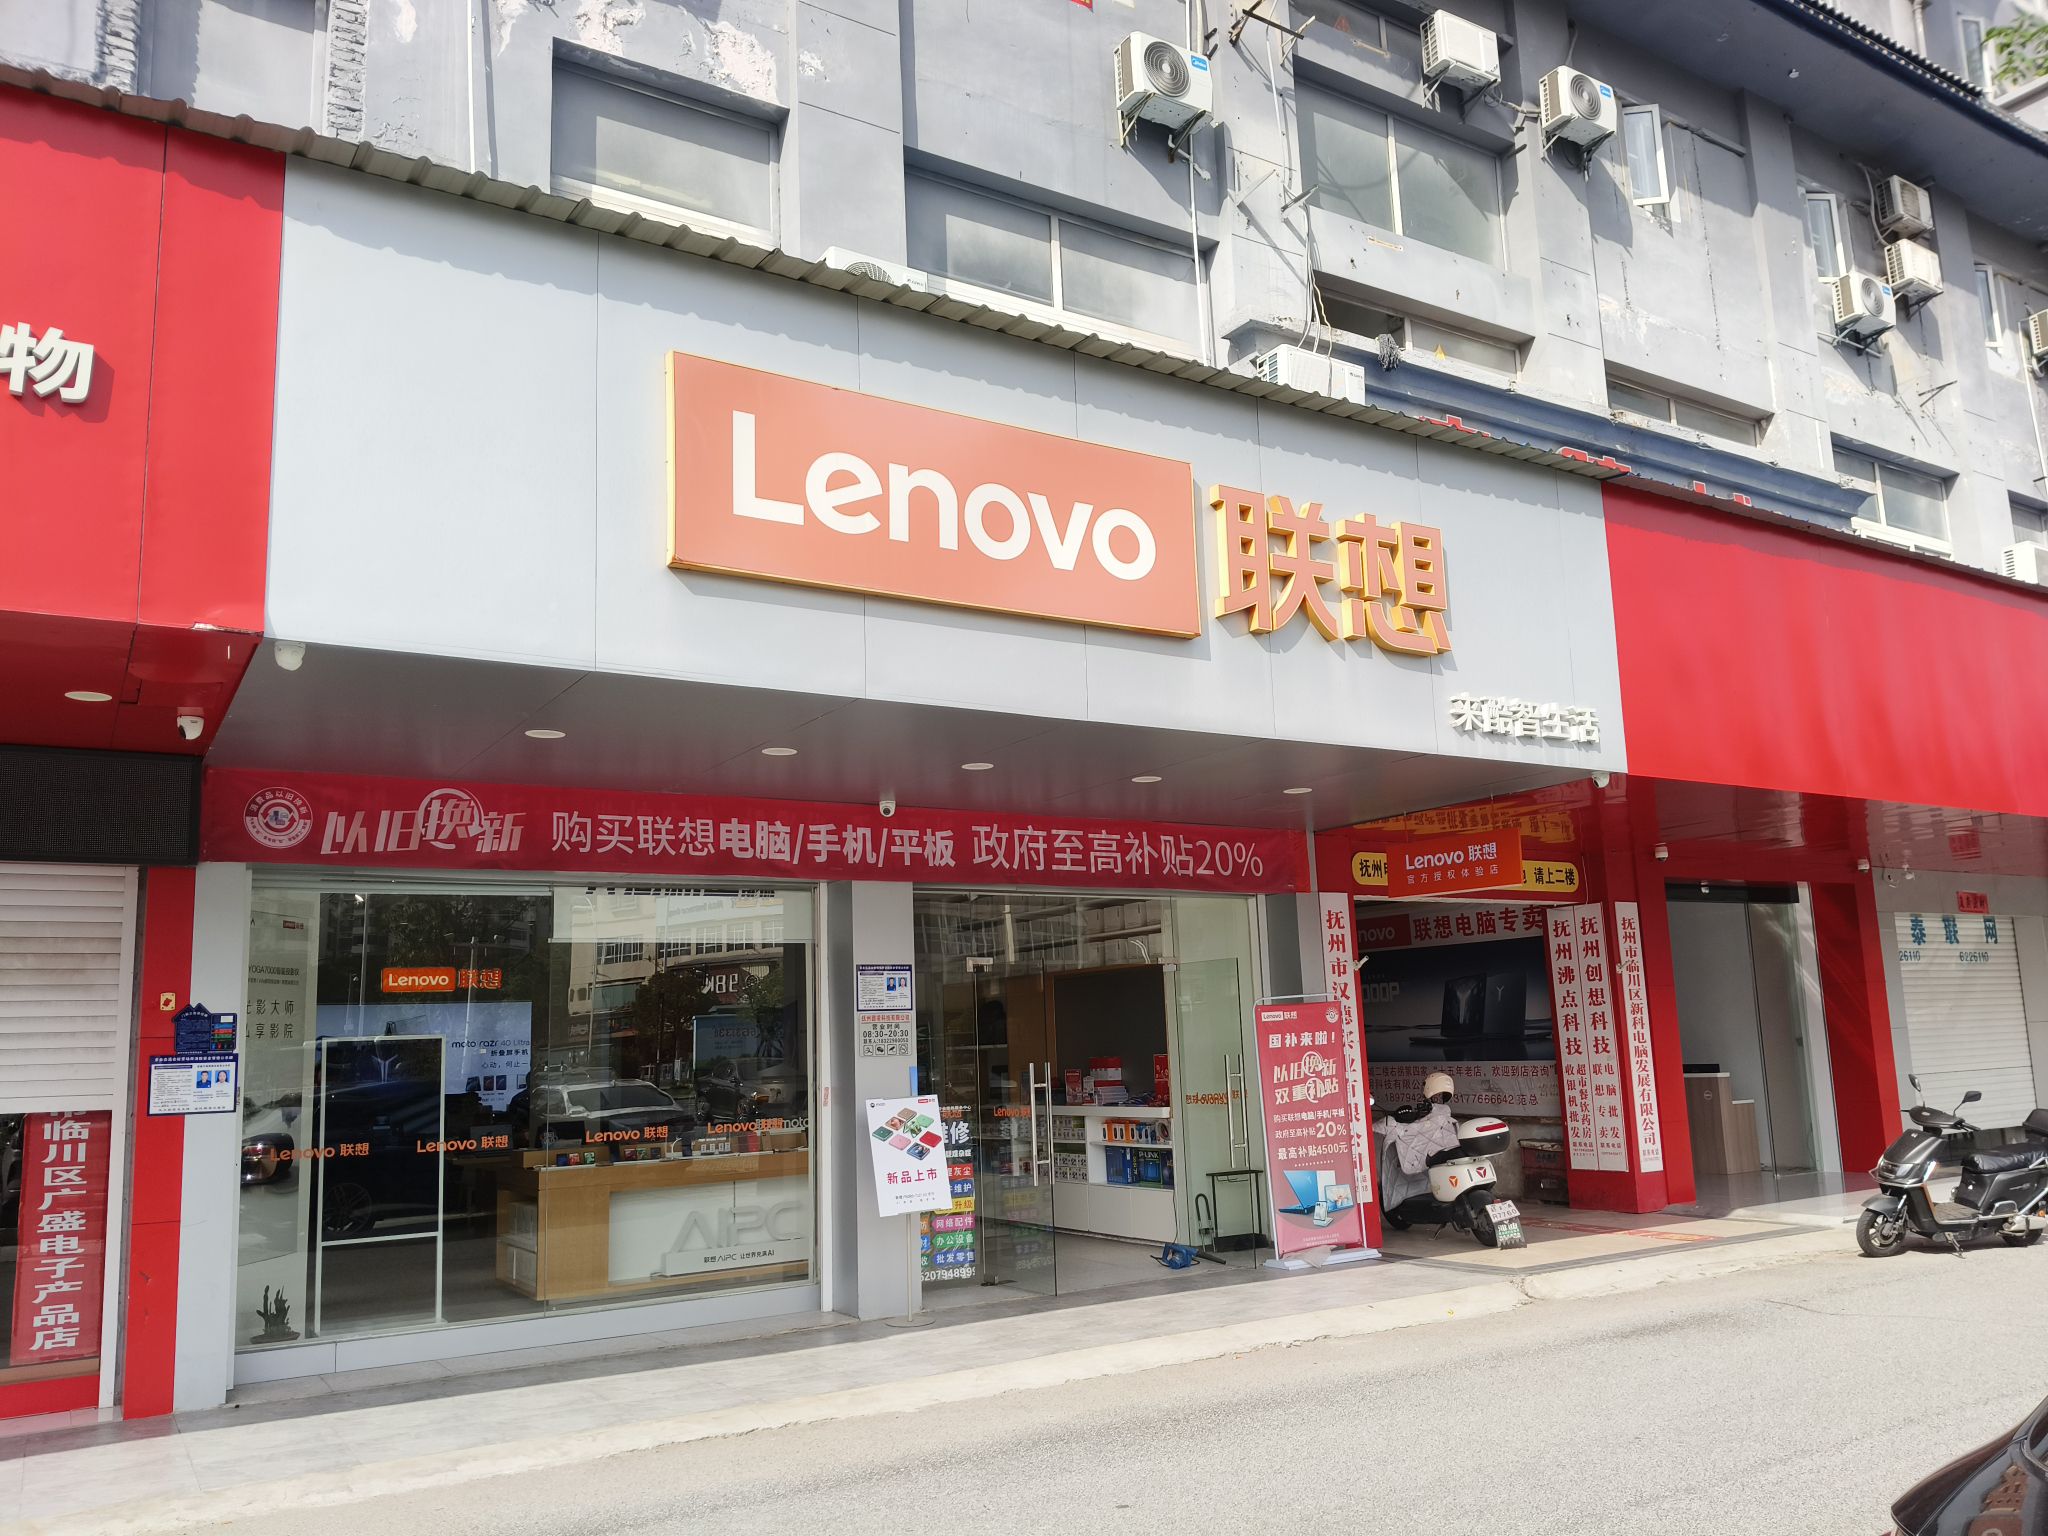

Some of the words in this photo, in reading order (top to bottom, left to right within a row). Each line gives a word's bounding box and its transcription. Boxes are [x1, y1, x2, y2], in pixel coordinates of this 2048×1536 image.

[731, 411, 1157, 582] Lenovo
[1209, 484, 1452, 658] 联想
[1449, 692, 1600, 743] 来酷智生活
[320, 788, 526, 855] 以旧换新
[551, 810, 957, 868] 购买联想电脑/手机/平板
[971, 824, 1264, 877] 政府至高补贴20%
[1405, 850, 1465, 870] Lenovo
[1467, 842, 1497, 860] 联想
[1406, 864, 1499, 885] 官方授权体验店
[1534, 867, 1576, 886] 请上二楼
[388, 973, 450, 986] Lenovo
[459, 968, 503, 989] 联想
[1553, 919, 1583, 1056] 抚州沸点科技
[1580, 916, 1610, 1054] 抚州创想科技
[452, 1040, 476, 1048] moto
[862, 1030, 909, 1038] 08:30-20:30
[585, 1129, 641, 1144] Lenovo
[643, 1125, 669, 1139] 联想
[707, 1118, 758, 1135] Lenovo
[270, 1146, 336, 1162] Lenovo
[339, 1142, 370, 1157] 联想
[416, 1138, 477, 1154] Lenovo
[481, 1135, 509, 1149] 联想
[1277, 1142, 1348, 1160] 最高补贴4500元
[887, 1167, 937, 1185] 新品上市
